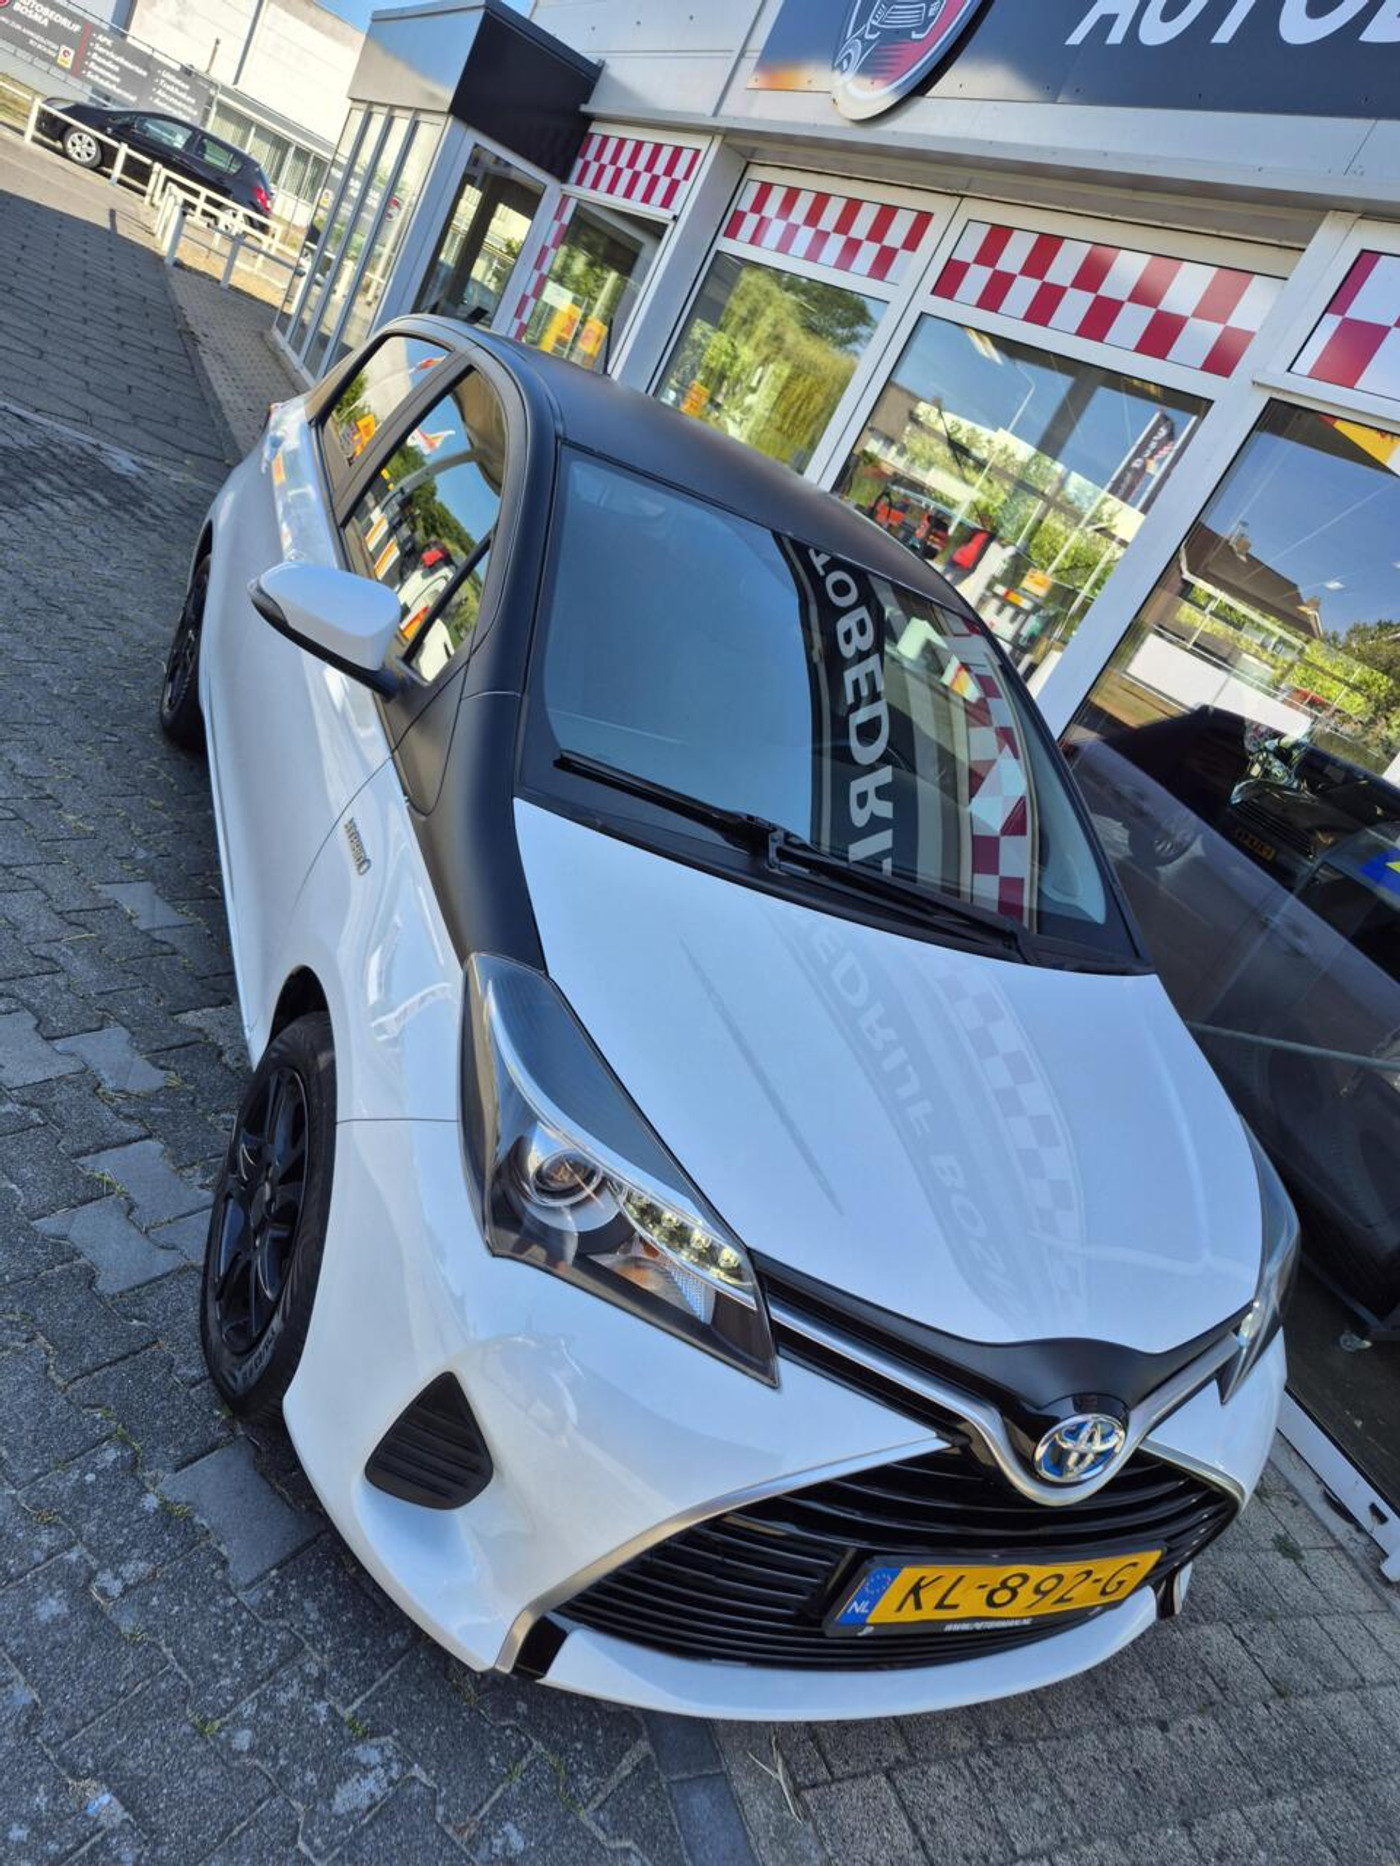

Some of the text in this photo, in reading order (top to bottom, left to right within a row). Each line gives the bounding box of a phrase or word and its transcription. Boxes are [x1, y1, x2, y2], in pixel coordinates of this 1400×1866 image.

[12, 1, 49, 28] BOSMA
[895, 1562, 1139, 1613] KL-892-G
[847, 1600, 870, 1614] NL
